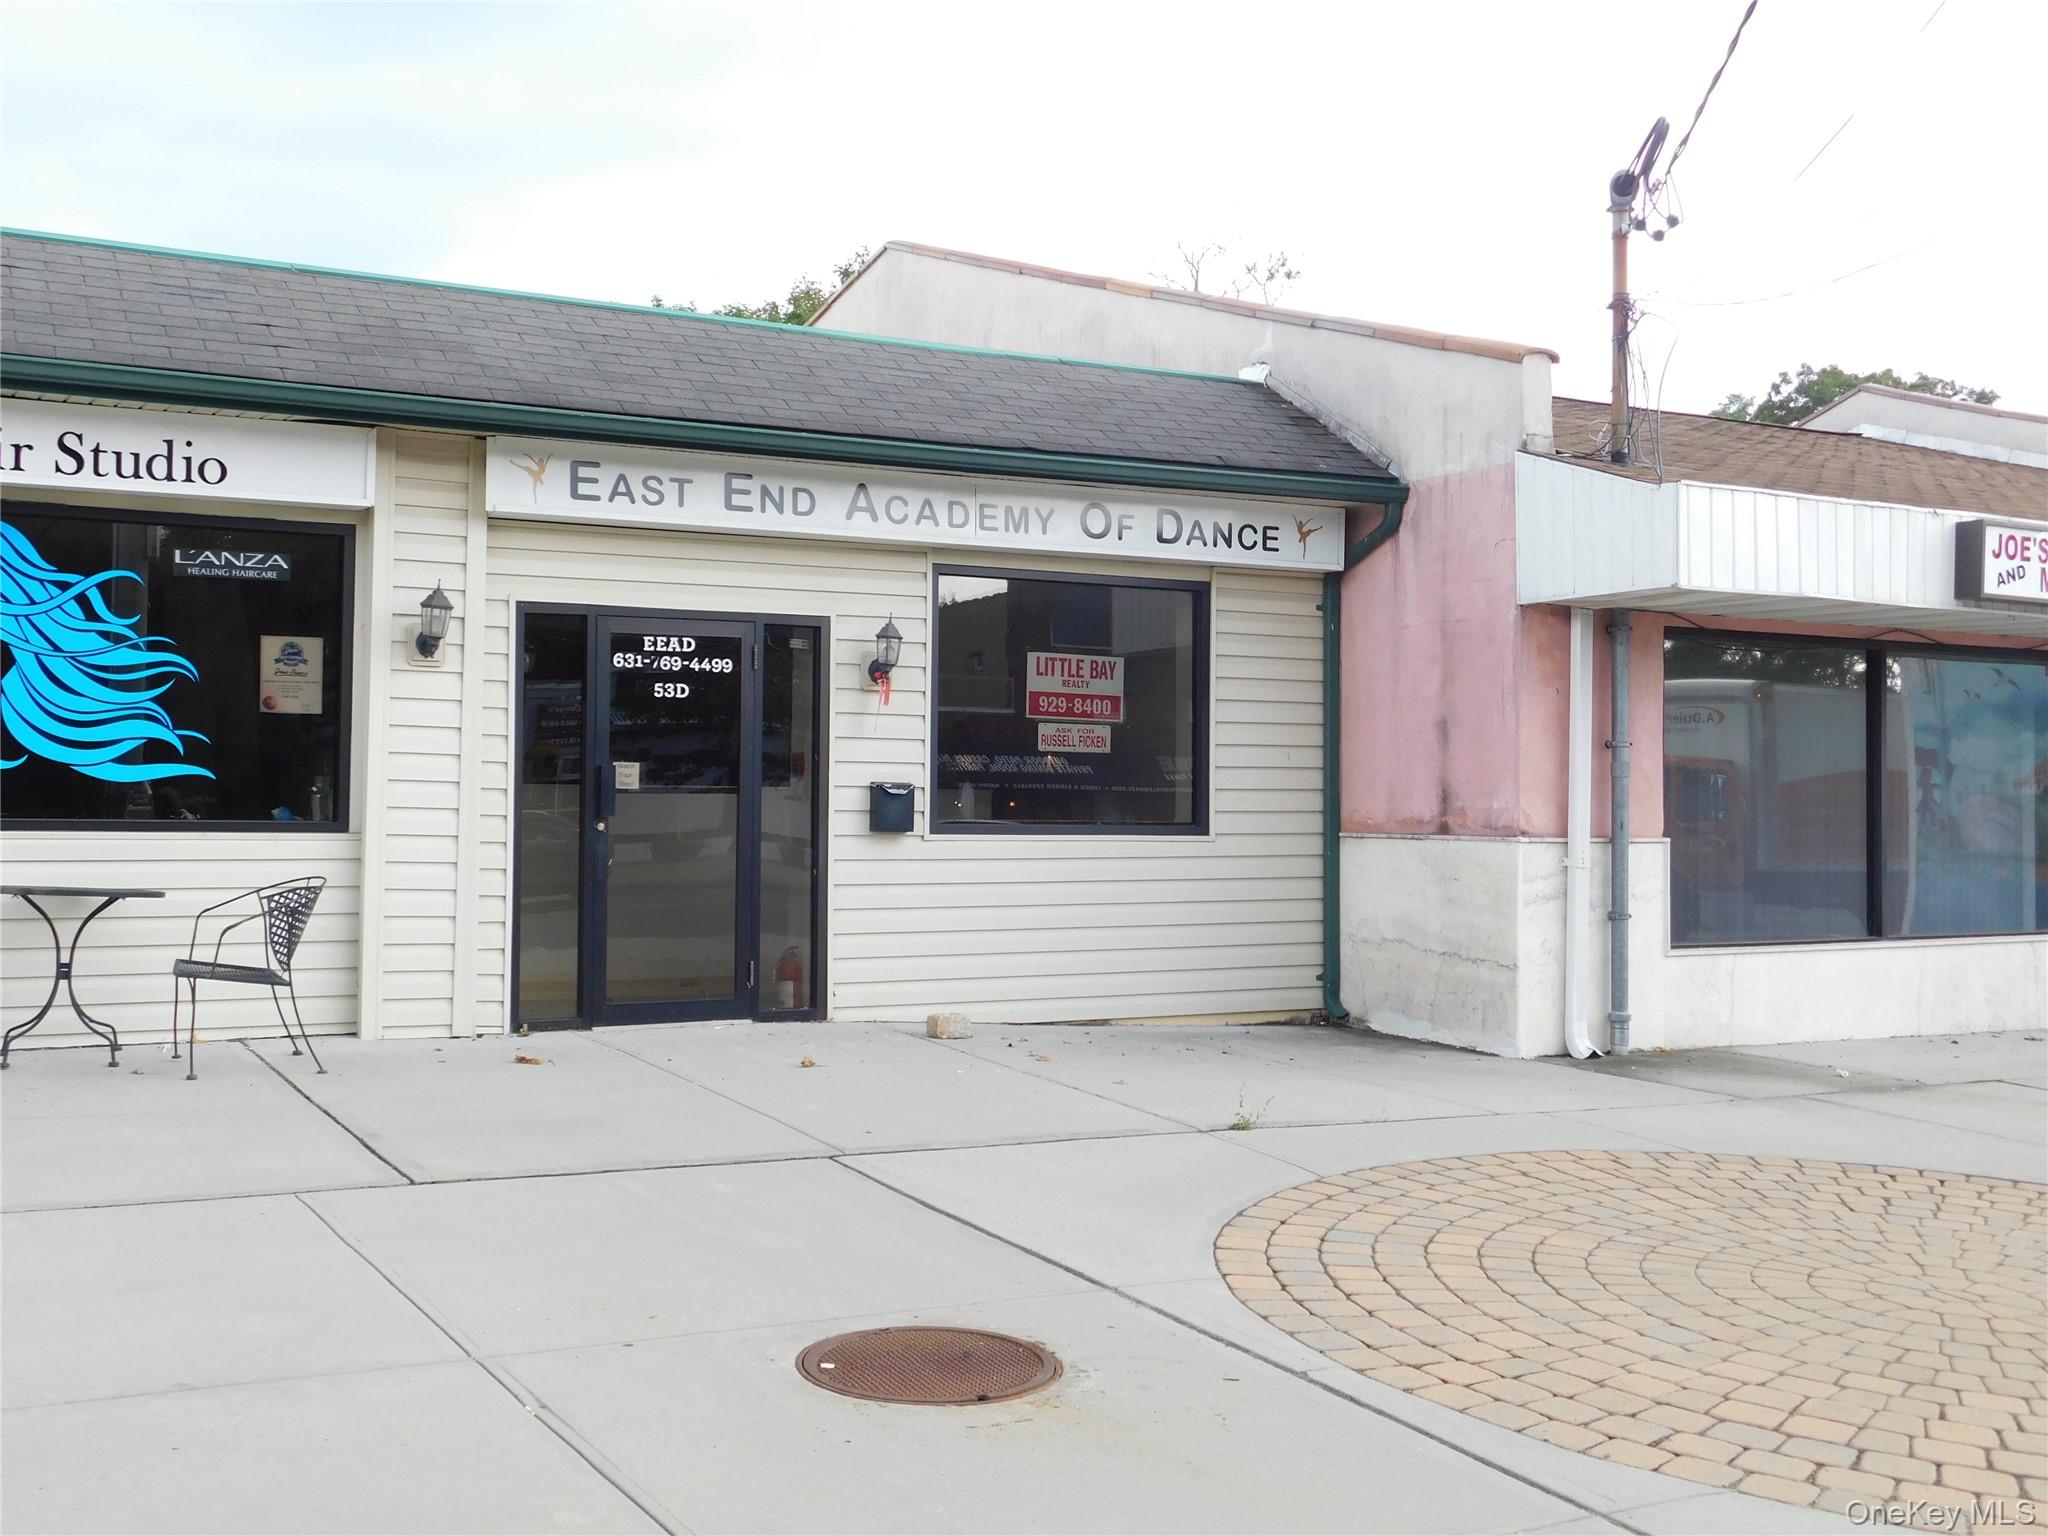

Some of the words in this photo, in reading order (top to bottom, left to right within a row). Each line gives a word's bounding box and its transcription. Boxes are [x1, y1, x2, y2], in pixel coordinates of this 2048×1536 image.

[54, 431, 228, 485] Studio
[569, 459, 694, 508] EAST
[723, 471, 817, 518] END
[845, 482, 1055, 536] ACADEMY
[1079, 502, 1136, 542] OF
[1155, 508, 1281, 553] DANCE
[1992, 533, 2048, 564] JOE'S
[174, 549, 289, 569] L'ANZA
[187, 566, 230, 577] HEALING
[231, 568, 279, 579] HAIRCARE
[1997, 564, 2026, 588] AND
[643, 636, 696, 652] EEAD
[612, 652, 733, 673] 631-769-4499
[1036, 656, 1085, 679] LITTLE
[1089, 660, 1117, 680] BAY
[653, 682, 690, 699] 53D
[1061, 679, 1090, 689] REALTY
[1039, 696, 1112, 715] 929-8400
[1041, 734, 1077, 748] RUSSELL
[1078, 736, 1107, 749] FICKEN
